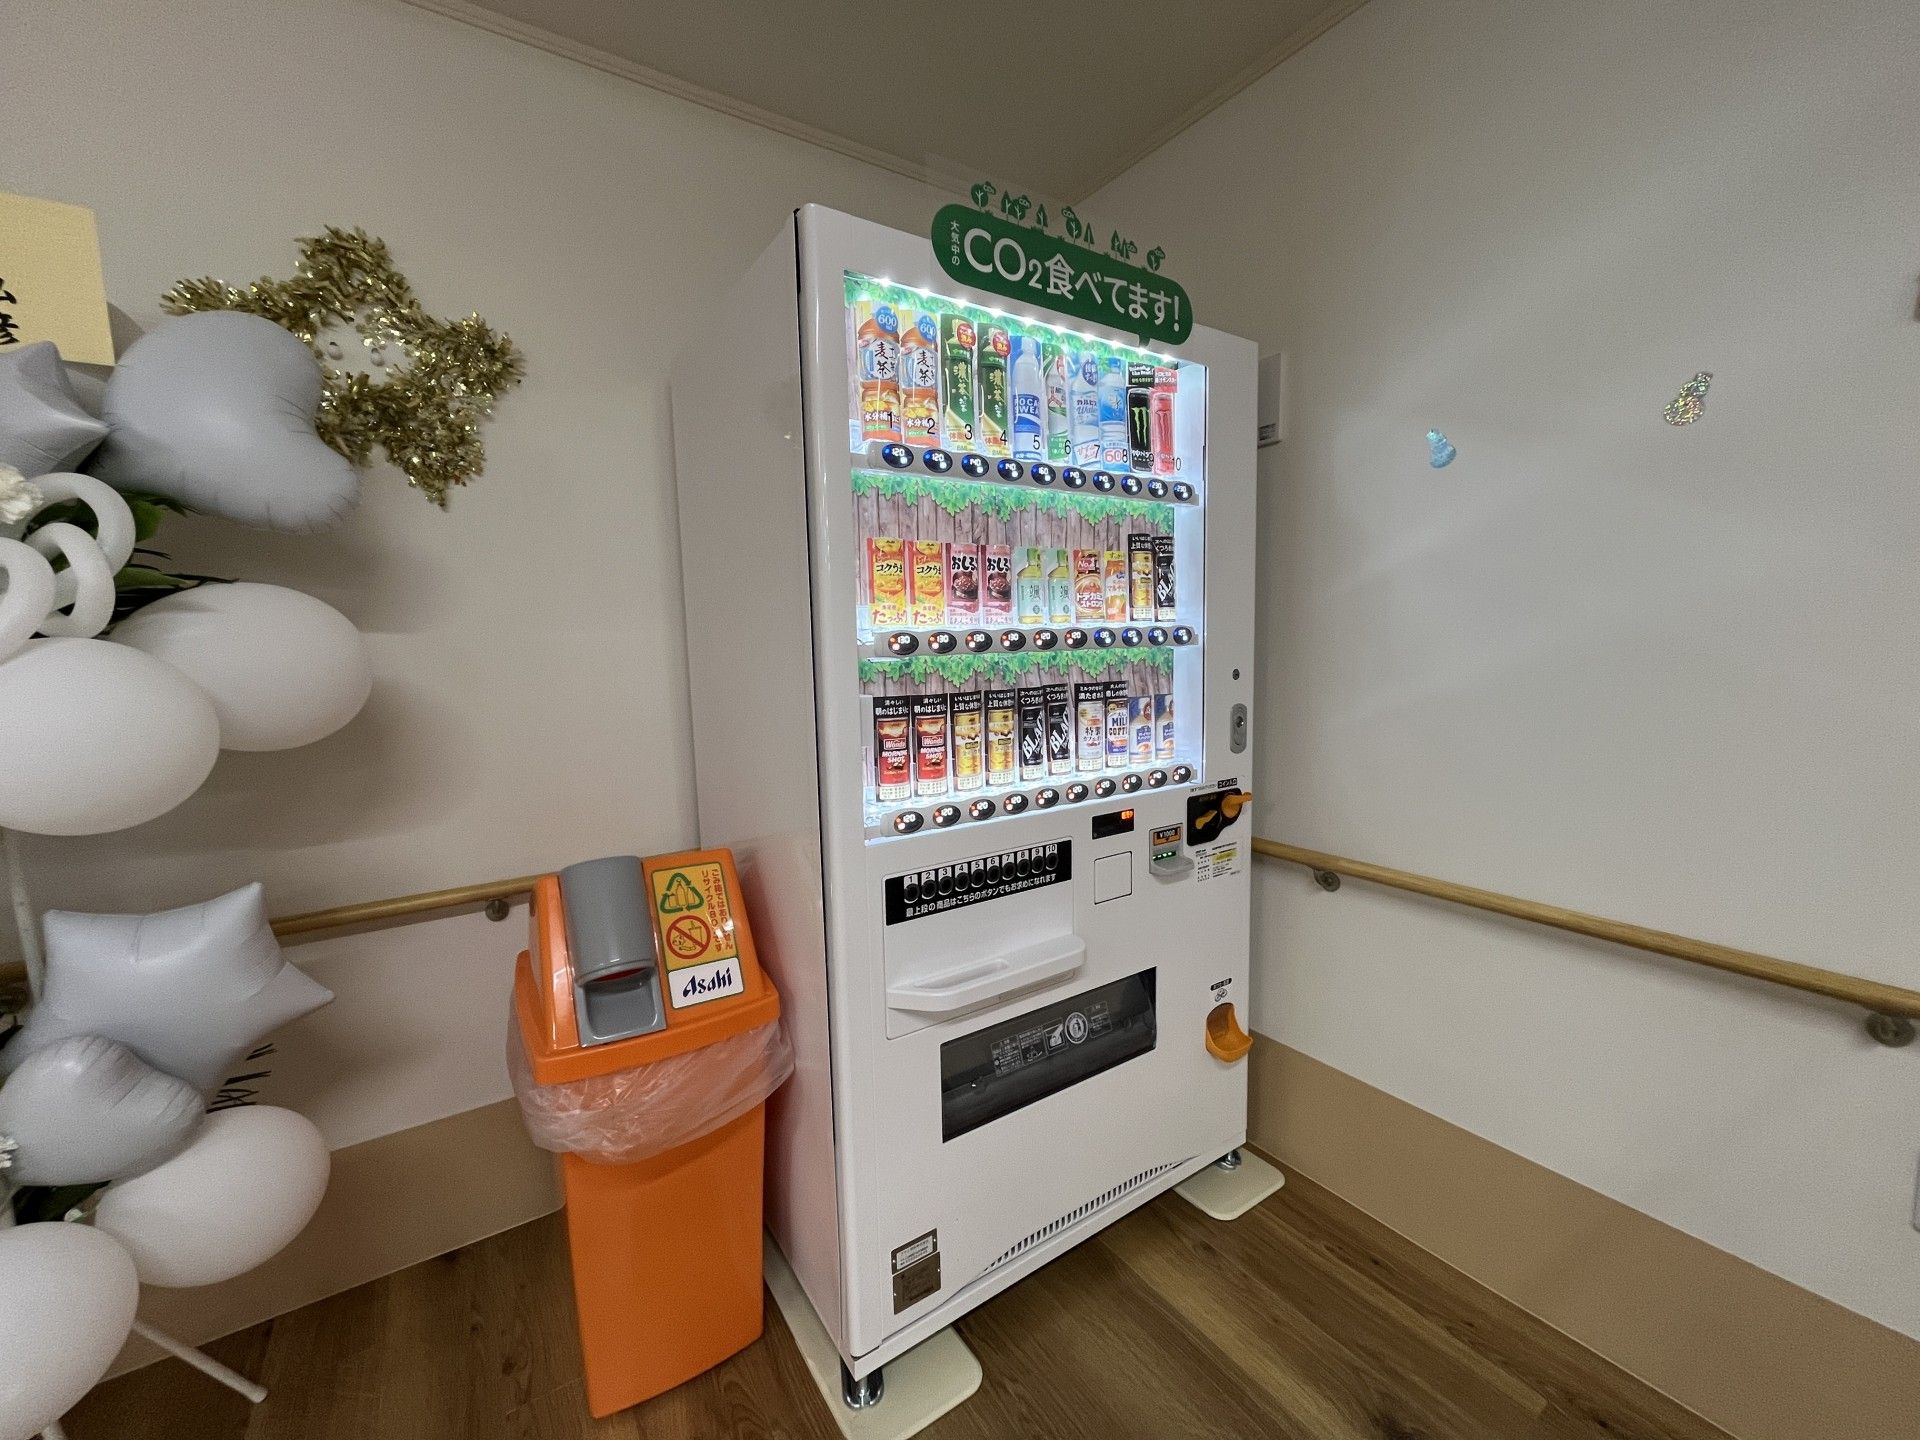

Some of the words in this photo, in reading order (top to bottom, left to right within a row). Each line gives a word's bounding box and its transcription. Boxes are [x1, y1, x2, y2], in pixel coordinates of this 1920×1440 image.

[887, 412, 893, 429] 1
[926, 417, 936, 435] 2
[964, 423, 973, 440] 3
[999, 429, 1008, 446] 4
[1032, 434, 1041, 450] 5
[1064, 439, 1072, 455] 6
[1093, 444, 1100, 459] 7
[1121, 448, 1129, 463] 8
[1034, 848, 1040, 856] 9
[1047, 845, 1056, 853] 10
[1005, 854, 1011, 862] 7
[1020, 851, 1026, 859] 8
[974, 861, 980, 869] 5
[990, 857, 996, 865] 6
[942, 868, 948, 876] 3
[958, 864, 964, 872] 4
[908, 875, 914, 883] 1
[925, 872, 931, 880] 2
[682, 966, 733, 998] Asahi
